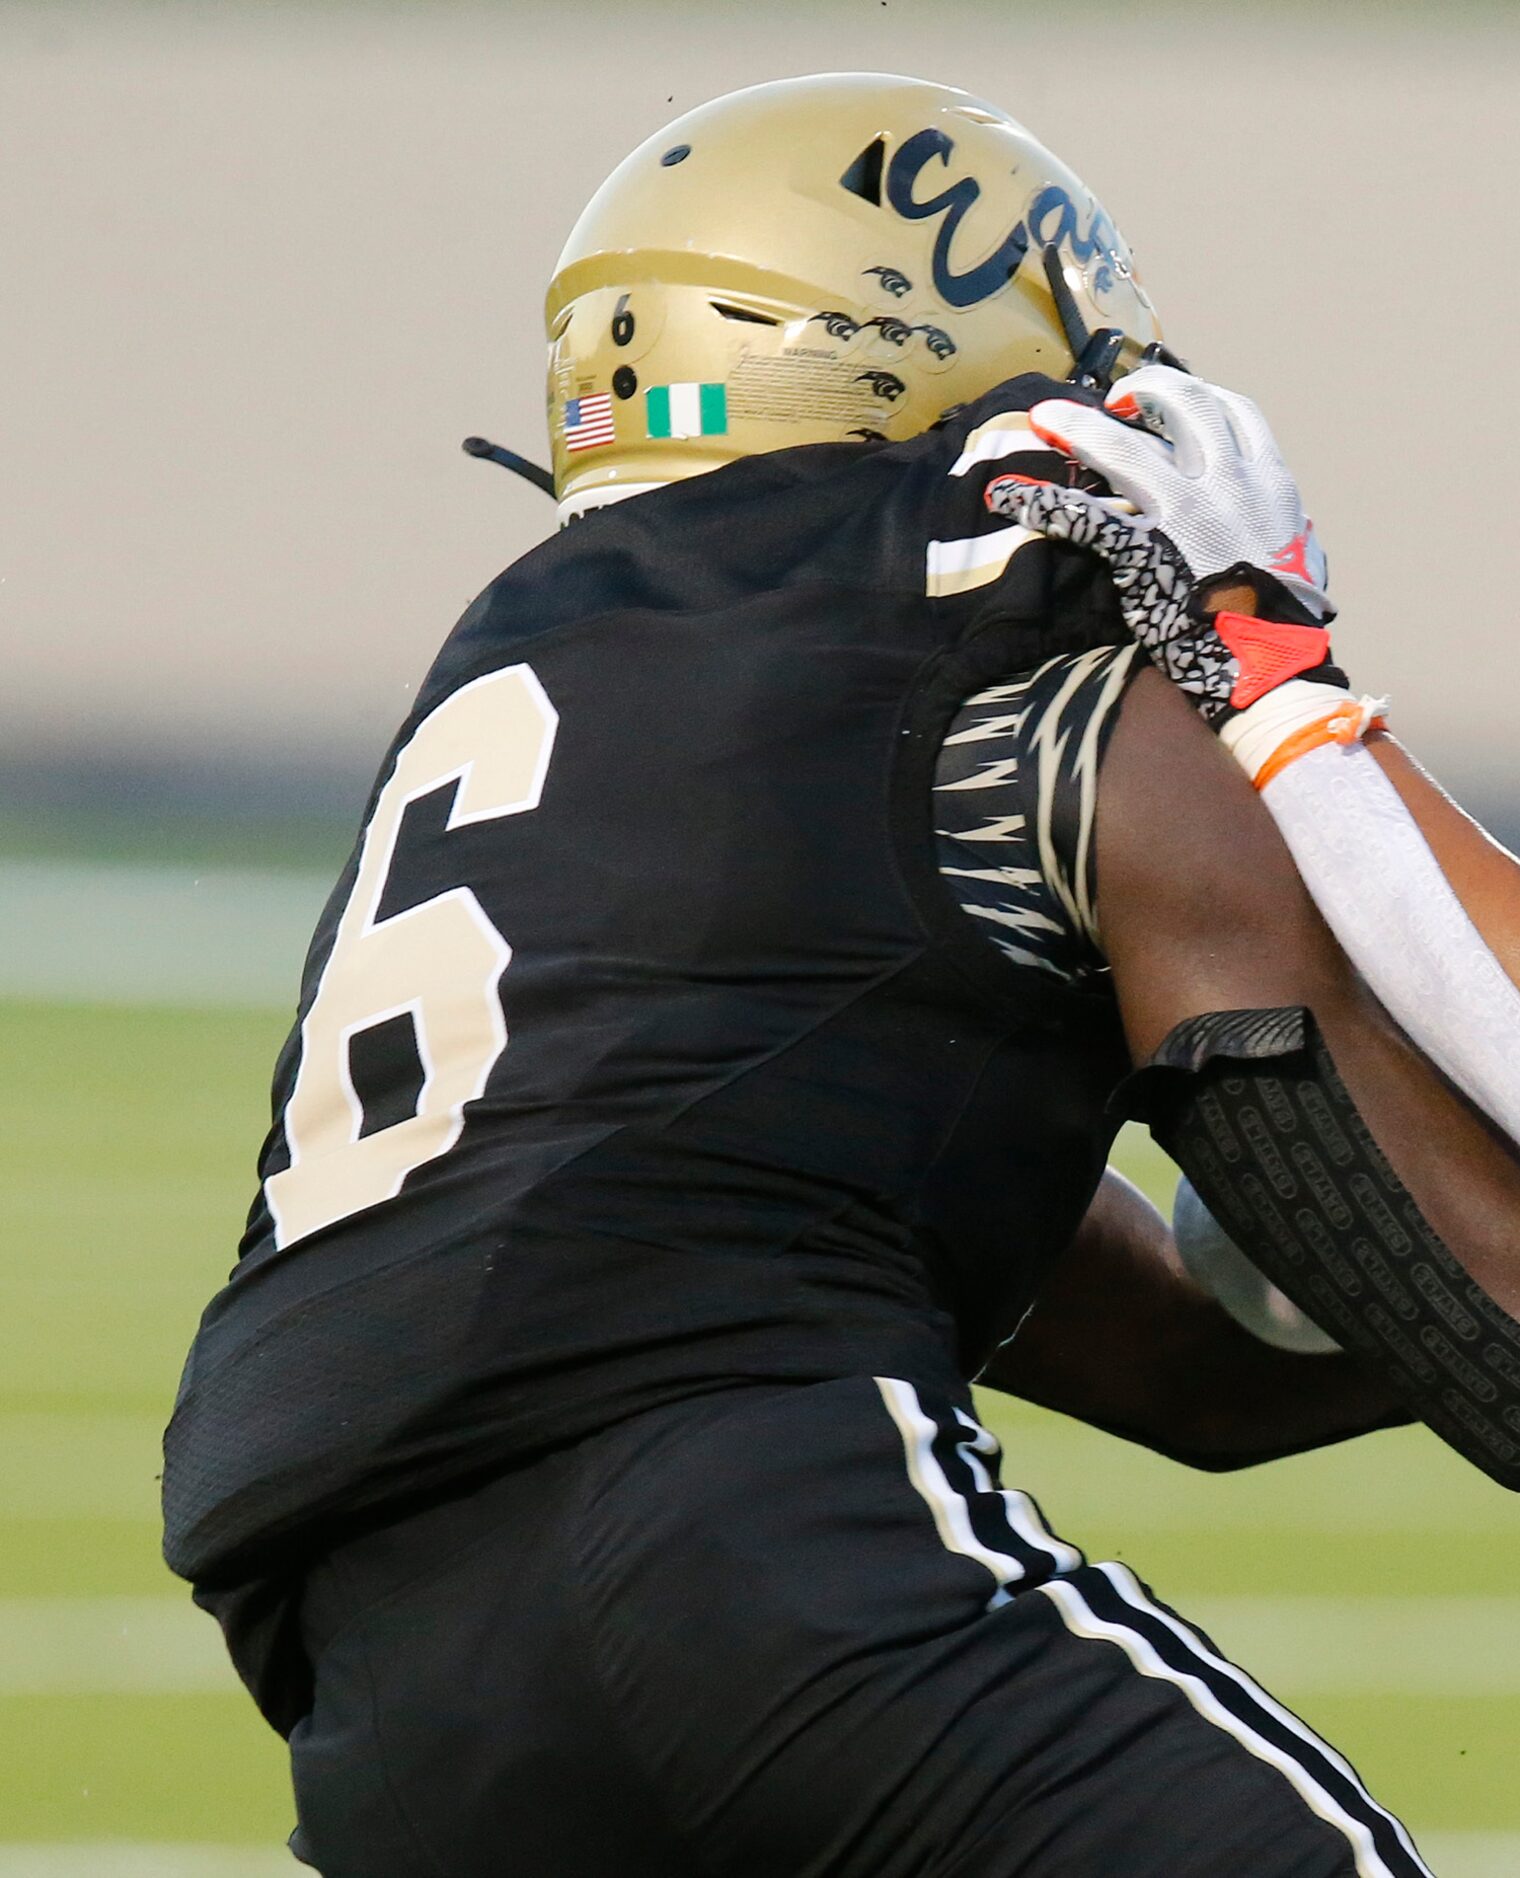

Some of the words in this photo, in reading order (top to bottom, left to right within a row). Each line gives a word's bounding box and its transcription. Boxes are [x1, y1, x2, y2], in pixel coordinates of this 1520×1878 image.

[612, 293, 634, 346] 6
[264, 662, 559, 1252] 6
[1352, 1177, 1407, 1249] BATTLE
[1411, 1265, 1474, 1334] BATTLE
